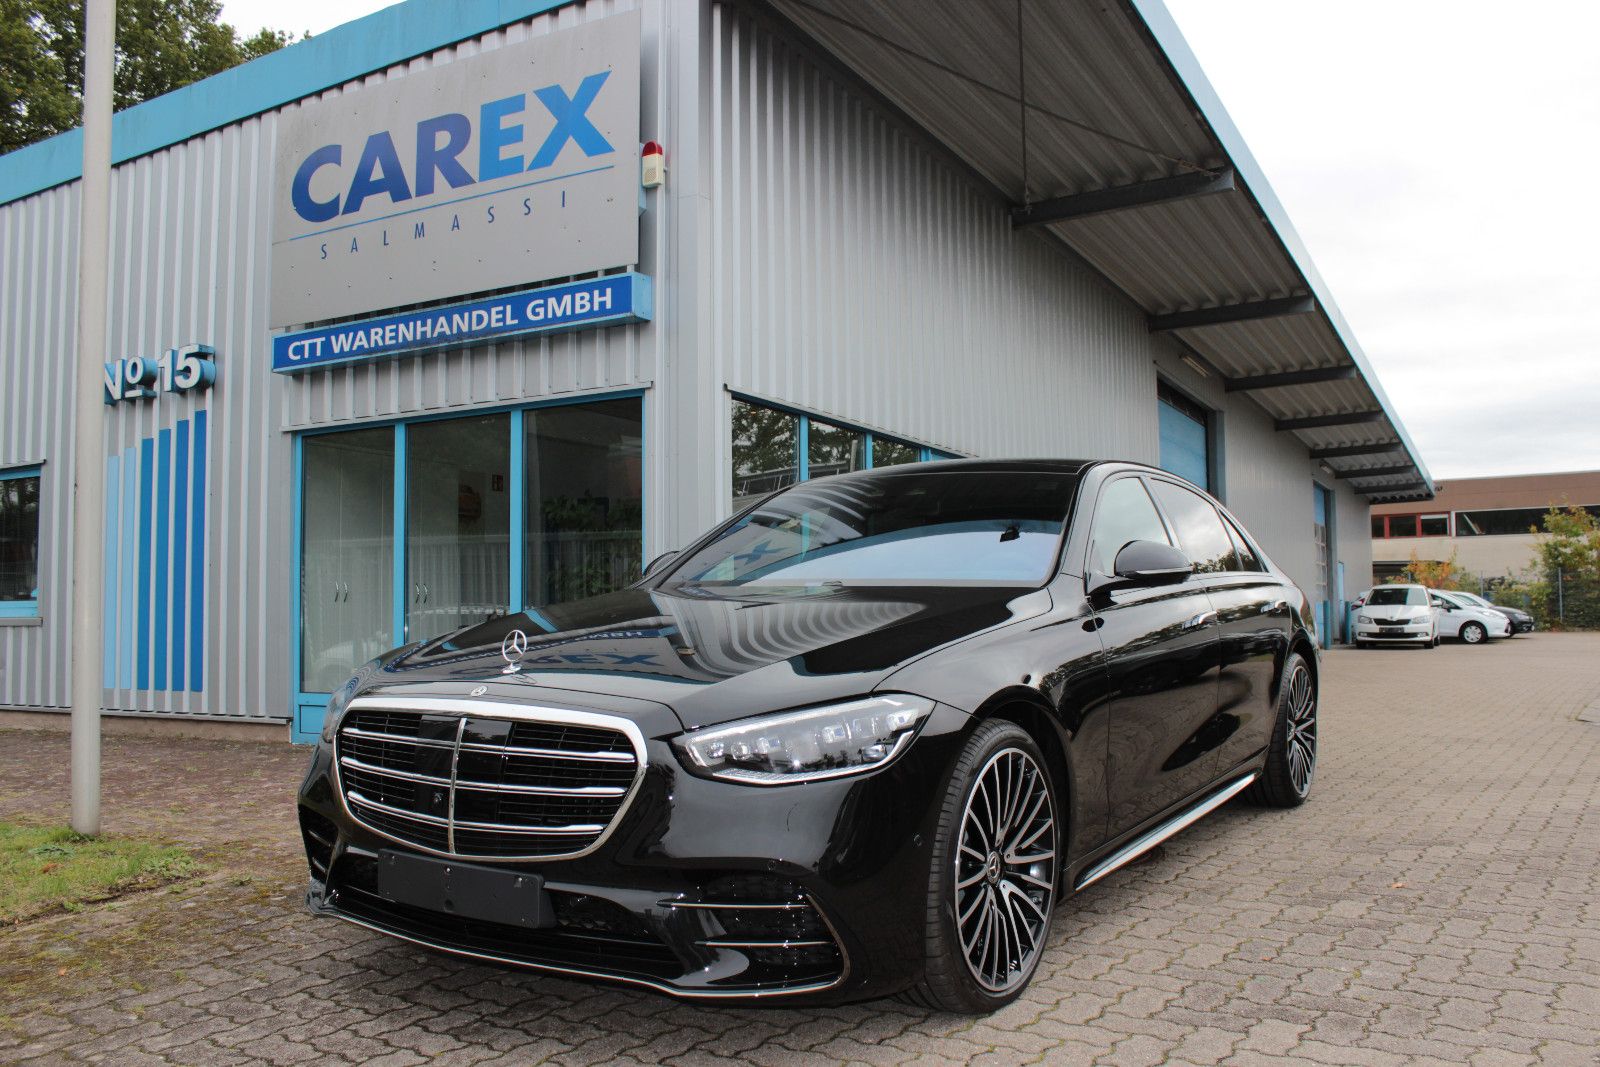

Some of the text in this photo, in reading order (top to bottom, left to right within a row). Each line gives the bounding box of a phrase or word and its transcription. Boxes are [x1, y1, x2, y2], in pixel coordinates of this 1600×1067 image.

[291, 70, 616, 223] CAREX
[320, 190, 566, 260] SALMASSI
[287, 287, 613, 362] CTT WARENHANDEL GMBH
[157, 343, 204, 393] 15
